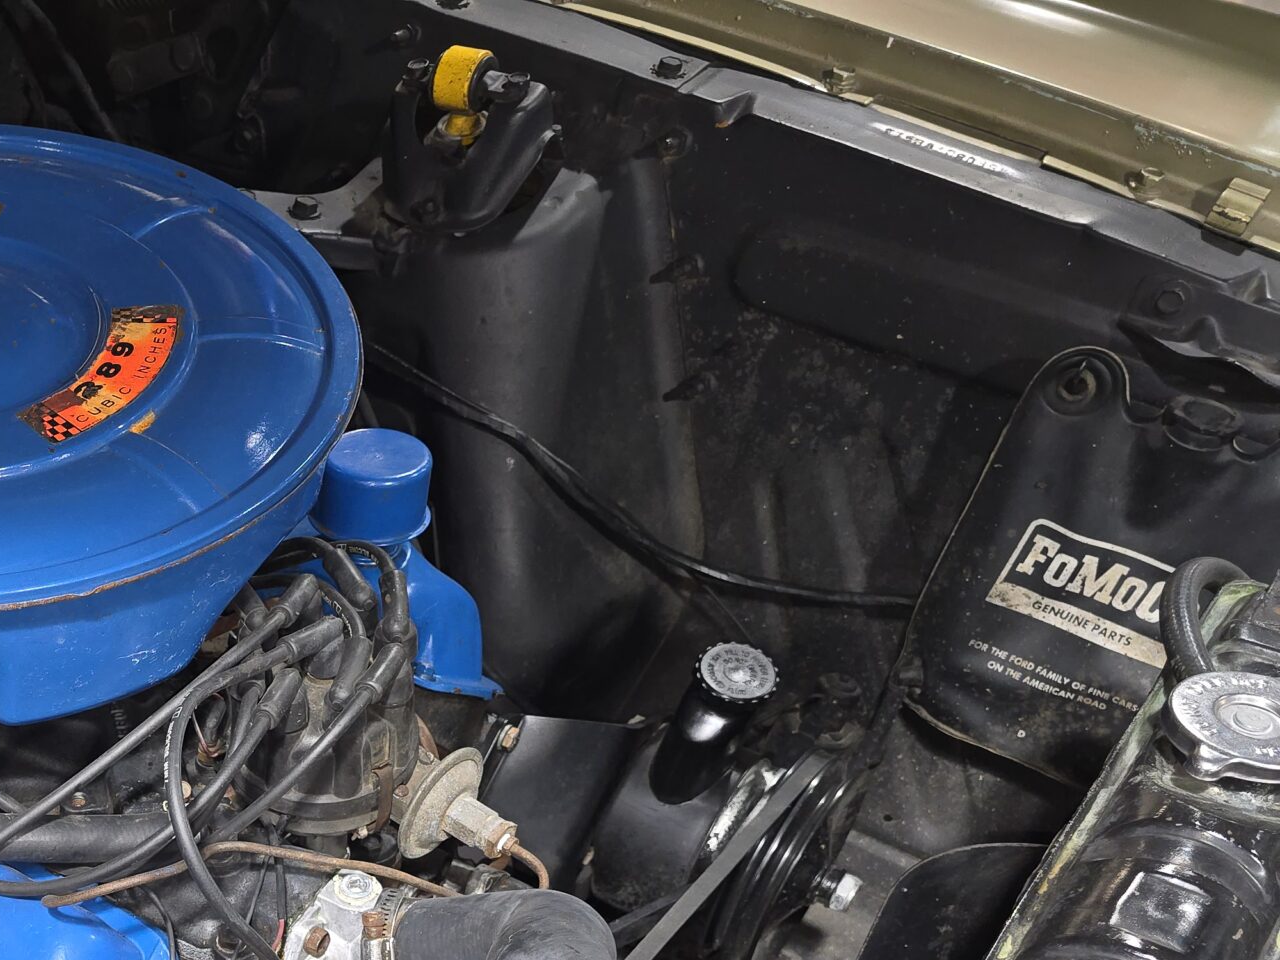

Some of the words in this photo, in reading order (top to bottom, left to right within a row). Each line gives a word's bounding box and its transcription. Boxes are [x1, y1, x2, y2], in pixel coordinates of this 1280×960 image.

[76, 386, 132, 423] CUBIC
[138, 326, 168, 379] INCHES
[1032, 600, 1090, 632] GENUINE
[1091, 623, 1132, 647] PARTS
[968, 639, 989, 653] FOR
[991, 646, 1009, 660] THE
[1008, 654, 1036, 671] FORD
[1035, 666, 1070, 685] FAMILY
[1071, 681, 1087, 692] OF
[1087, 686, 1110, 700] FINE
[987, 660, 1004, 673] ON
[1005, 667, 1022, 681] THE
[1023, 676, 1075, 700] AMERICAN
[1077, 695, 1107, 711] ROAD
